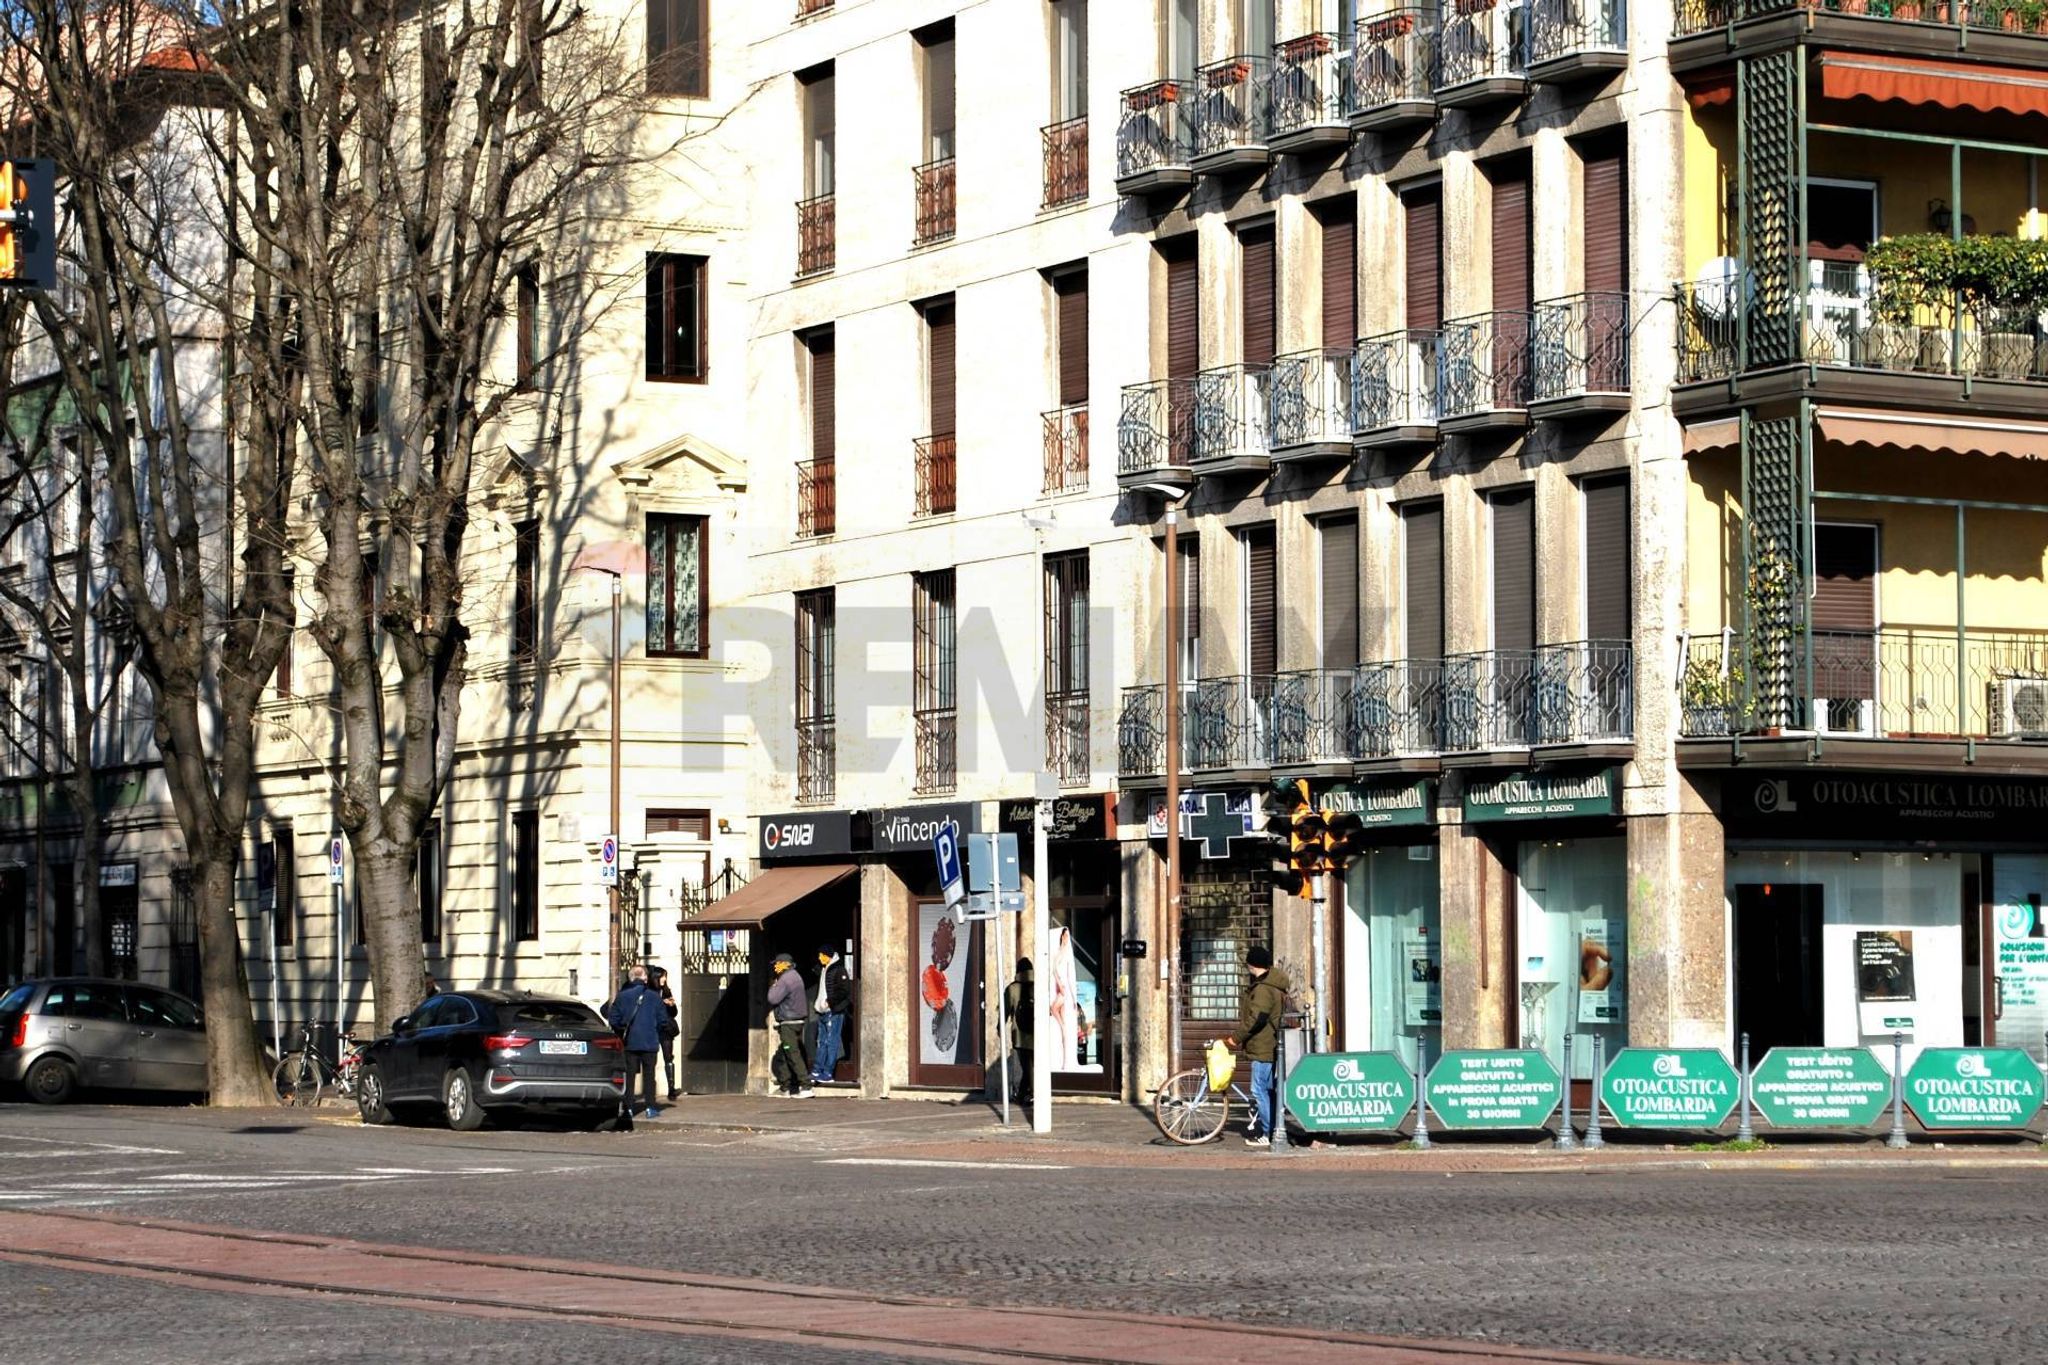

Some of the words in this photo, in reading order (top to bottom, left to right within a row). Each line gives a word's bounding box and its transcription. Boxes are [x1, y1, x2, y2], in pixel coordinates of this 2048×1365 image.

[1368, 787, 1422, 810] LOMBARDA
[1470, 780, 1543, 805] OTOACUSTICA
[1547, 776, 1609, 801] LOMBARDA
[1813, 781, 1958, 807] OTOACUSTICA
[1056, 801, 1096, 823] Bellezza
[938, 834, 952, 881] P
[1461, 1058, 1488, 1068] TEST
[1491, 1058, 1524, 1067] UDITO
[1461, 1071, 1515, 1081] GRATUITO
[1296, 1082, 1404, 1100] OTOACUSTICA
[1433, 1084, 1500, 1094] APPARECCHI
[1502, 1083, 1554, 1093] ACUSTICI
[1612, 1078, 1728, 1095] OTOACUSTICA
[1914, 1078, 2034, 1096] OTOACUSTICA
[1308, 1100, 1395, 1117] LOMBARDA
[1461, 1097, 1497, 1106] PROVA
[1499, 1096, 1538, 1105] GRATIS
[1625, 1096, 1717, 1112] LOMBARDA
[1928, 1097, 2022, 1113] LOMBARDA
[1467, 1109, 1480, 1119] 30
[1482, 1109, 1521, 1118] GIORNI
